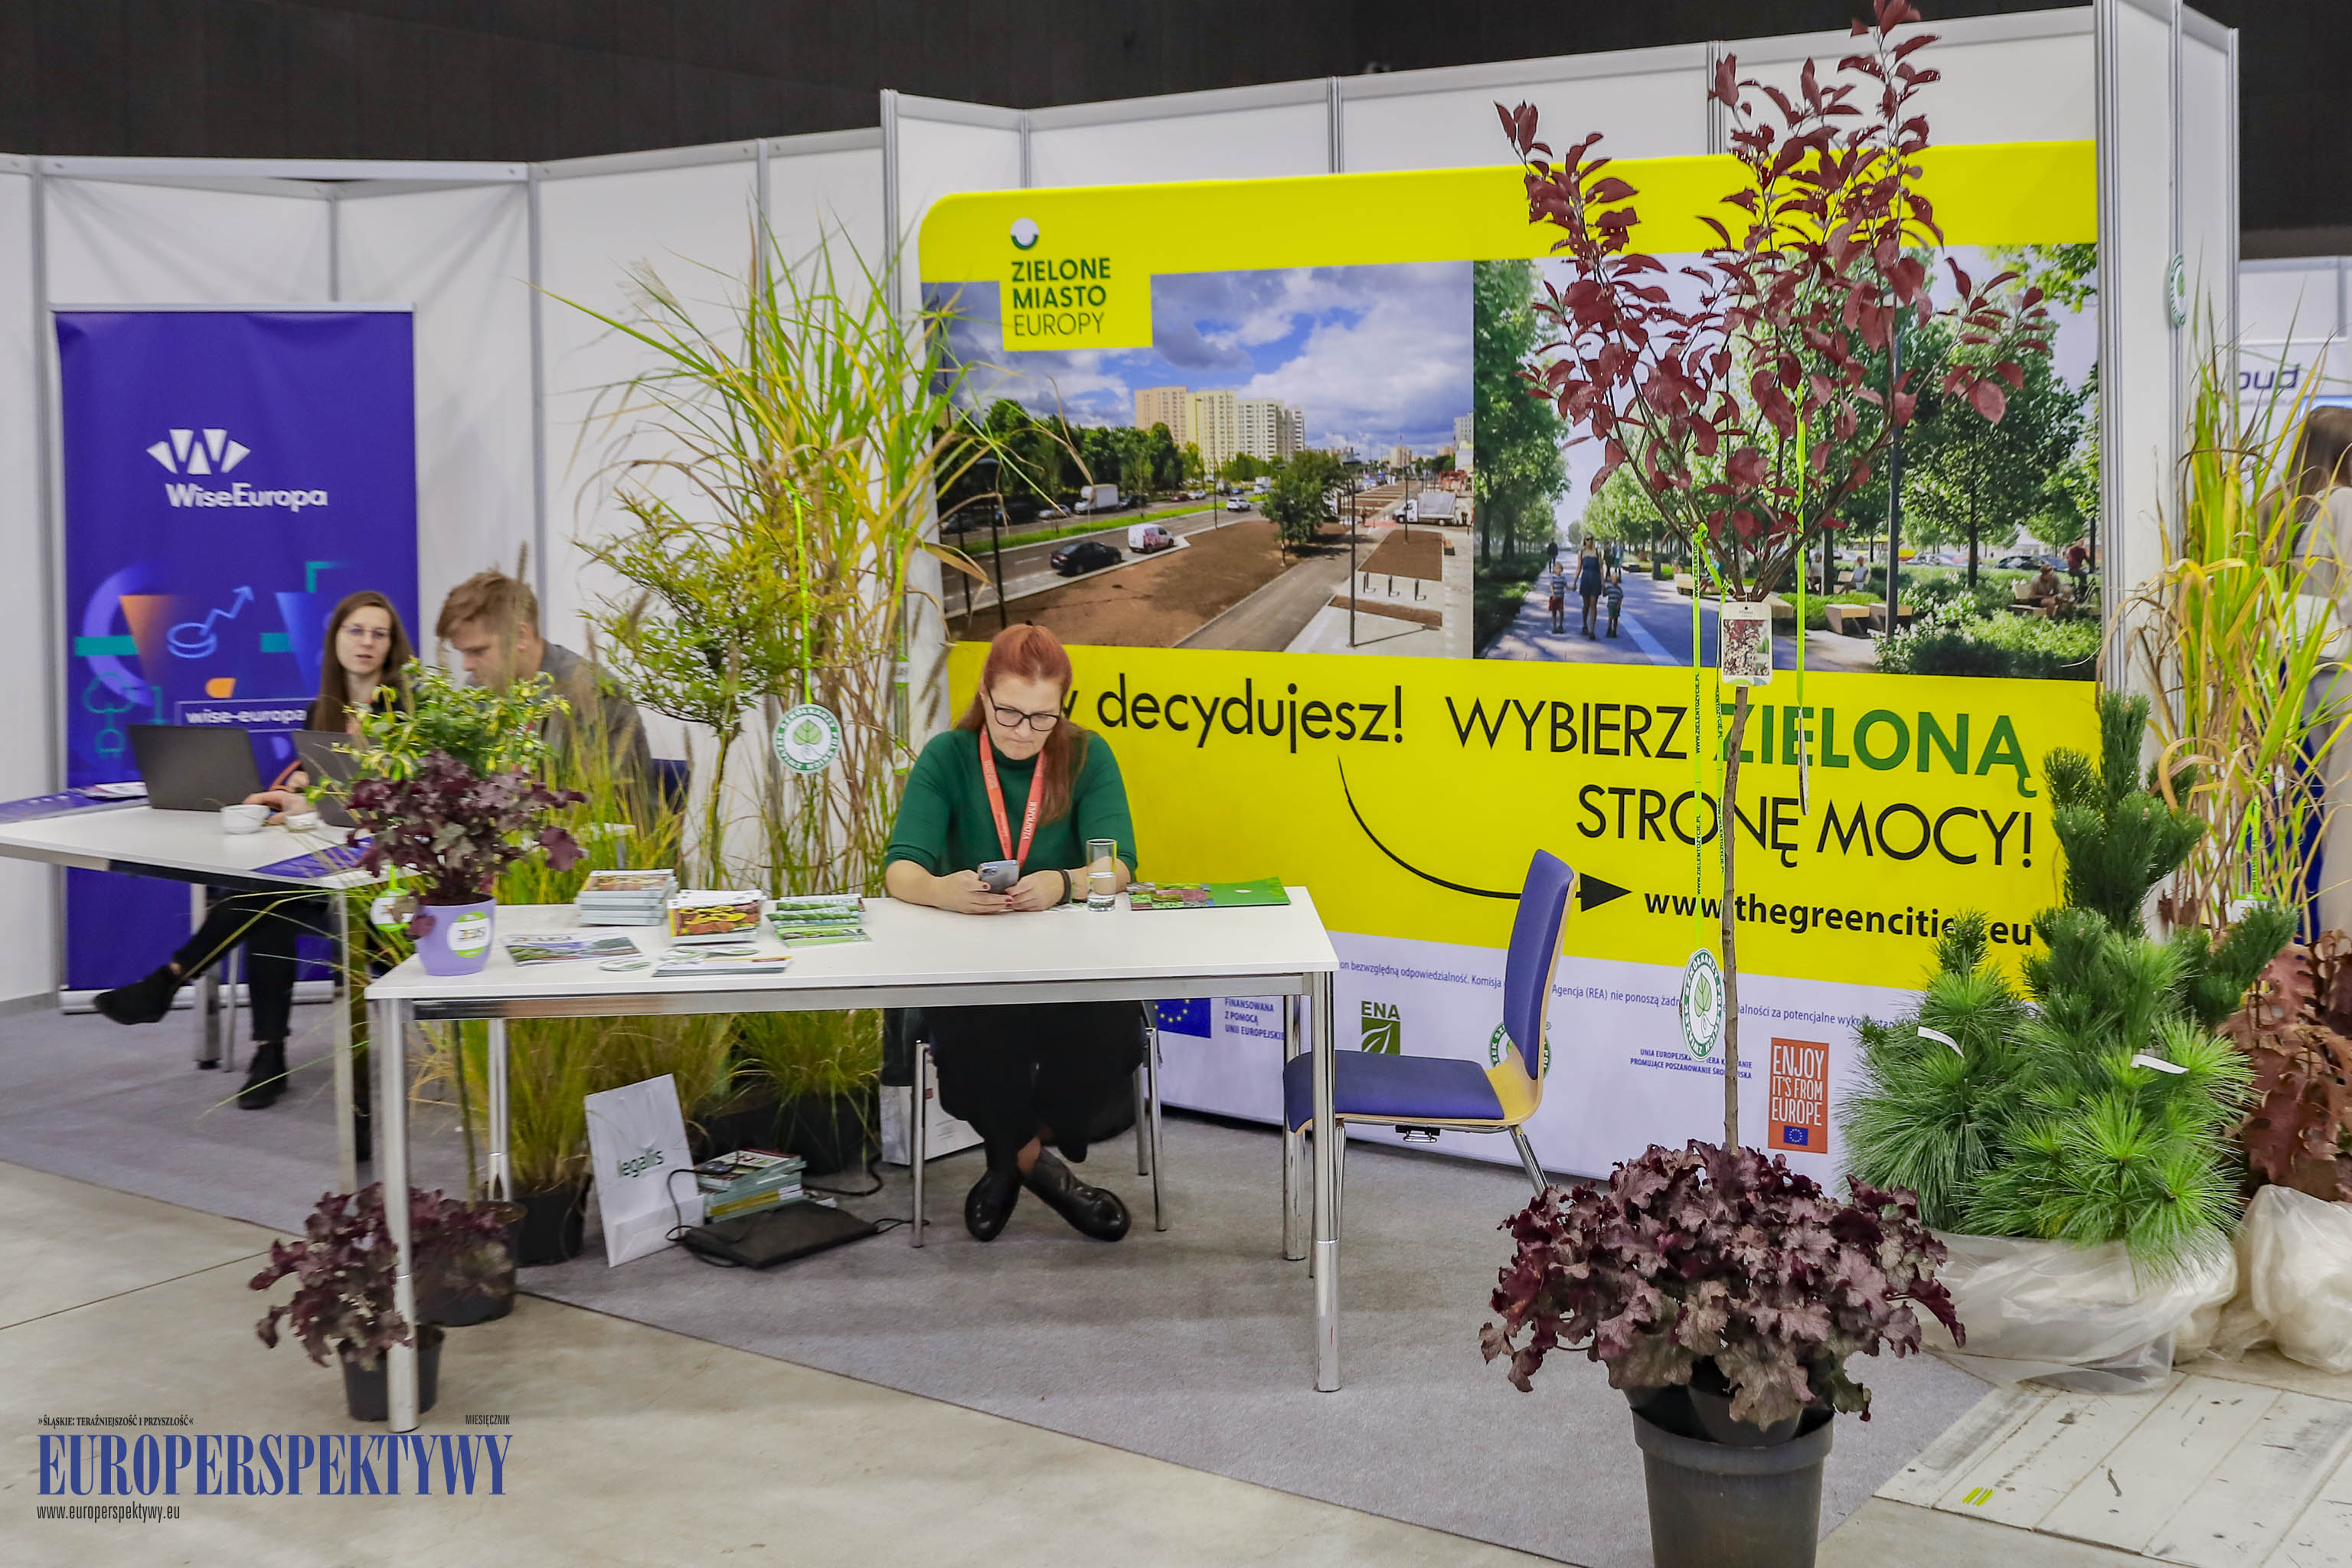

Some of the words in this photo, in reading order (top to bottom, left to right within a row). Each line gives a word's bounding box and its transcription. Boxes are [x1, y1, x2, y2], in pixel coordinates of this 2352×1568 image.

[1011, 257, 1111, 283] ZIELONE
[1013, 285, 1106, 309] MIASTO
[1014, 312, 1105, 337] EUROPY
[165, 482, 328, 513] WiseEuropa
[1096, 673, 1403, 754] decydujesz!
[1445, 696, 1688, 760] WYBIERZ
[1713, 703, 2037, 799] ZIELONĄ
[1576, 783, 1799, 868] STRONĘ
[1817, 799, 2032, 869] MOCY!
[1225, 998, 1275, 1012] FINANSOWANA
[1351, 960, 1400, 978] bezwzględną
[1400, 968, 1471, 985] odpowiedzialność.
[1471, 975, 1502, 990] Komisja
[1551, 984, 1584, 999] Agencja
[1585, 986, 1609, 1001] (REA)
[1610, 989, 1624, 1001] nie
[1625, 992, 1660, 1008] ponoszą
[1771, 1008, 1782, 1018] za
[1783, 1008, 1836, 1025] potencjalne
[1225, 1011, 1230, 1020] Z
[1230, 1011, 1259, 1026] POMOCĄ
[1361, 1000, 1401, 1021] ENA
[1241, 1026, 1285, 1040] EUROPEJSKIE
[1640, 1048, 1655, 1057] UNIA
[1772, 1044, 1825, 1080] ENJOY
[1630, 1058, 1664, 1070] PROMUJĄCE
[1664, 1062, 1711, 1075] POSZANOWANIE
[1772, 1075, 1792, 1098] IT'S
[1794, 1076, 1824, 1101] FROM
[1771, 1096, 1823, 1126] EUROPE
